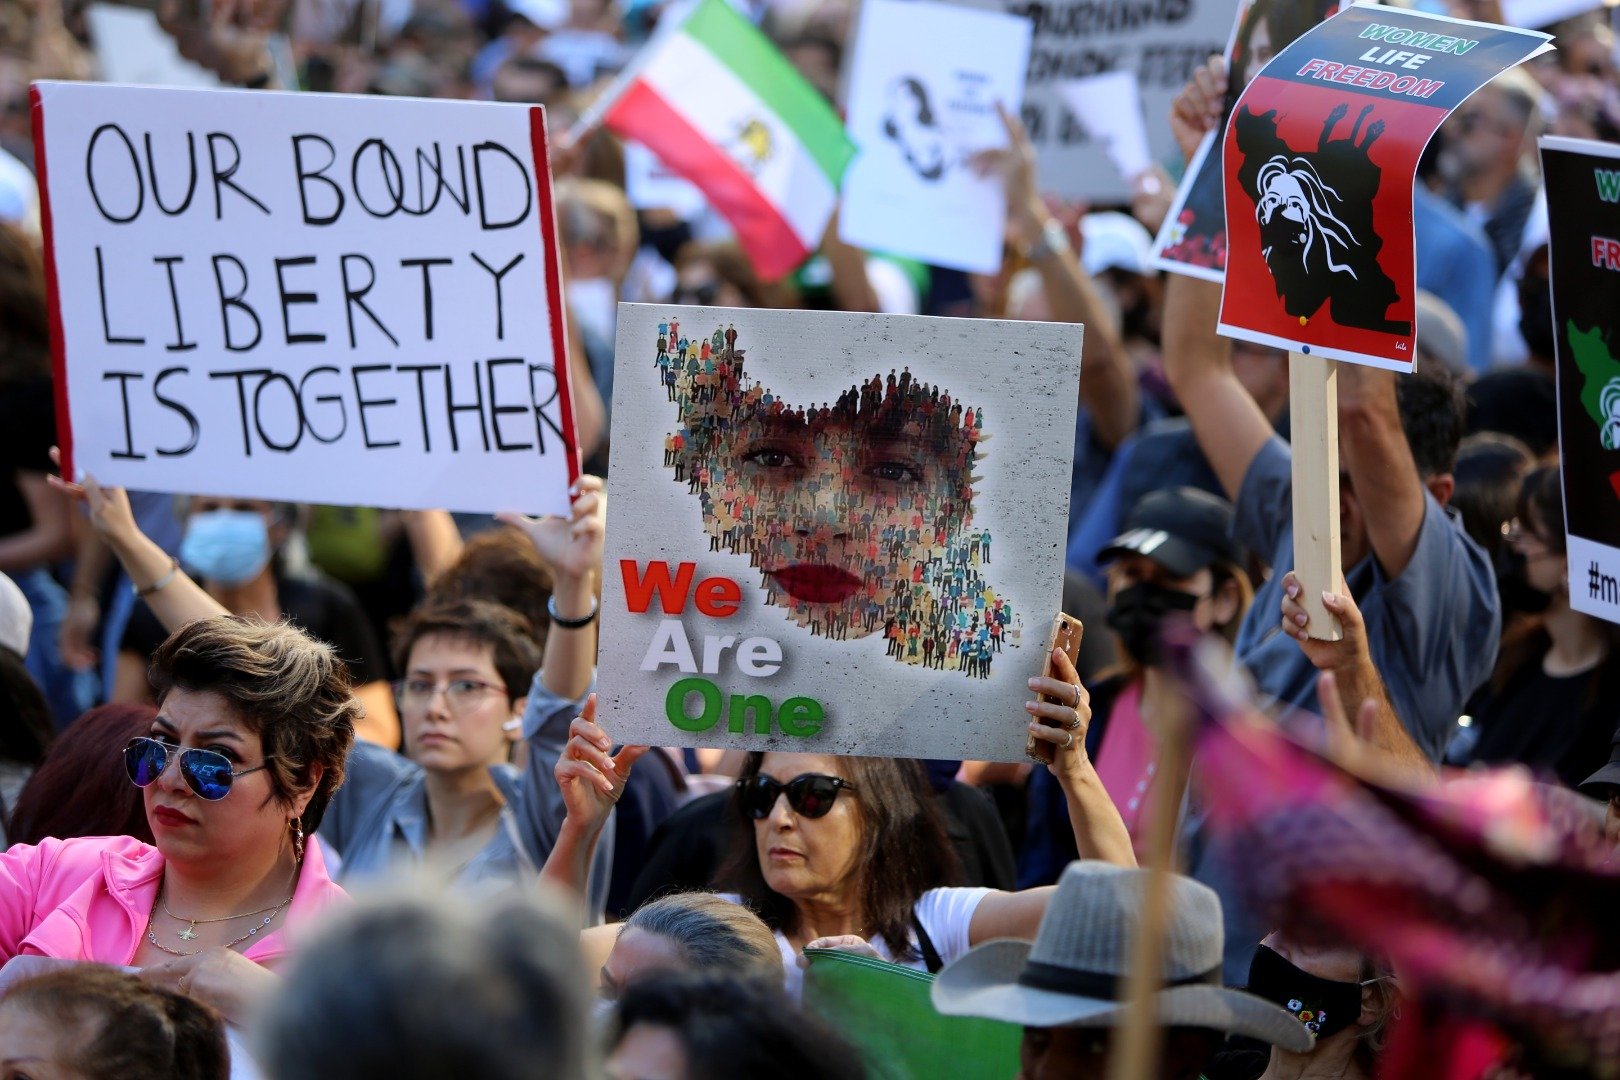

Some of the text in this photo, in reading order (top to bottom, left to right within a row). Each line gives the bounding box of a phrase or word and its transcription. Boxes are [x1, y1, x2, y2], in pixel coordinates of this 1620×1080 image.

[1358, 23, 1479, 56] WOMEN
[1358, 46, 1432, 70] LIFE
[1296, 58, 1445, 99] FREEDOM
[87, 123, 271, 224] OUR
[95, 246, 525, 351] LIBERTY
[103, 359, 575, 461] IS TOGETHER
[620, 559, 742, 617] We
[639, 619, 783, 677] Are
[665, 677, 825, 738] One
